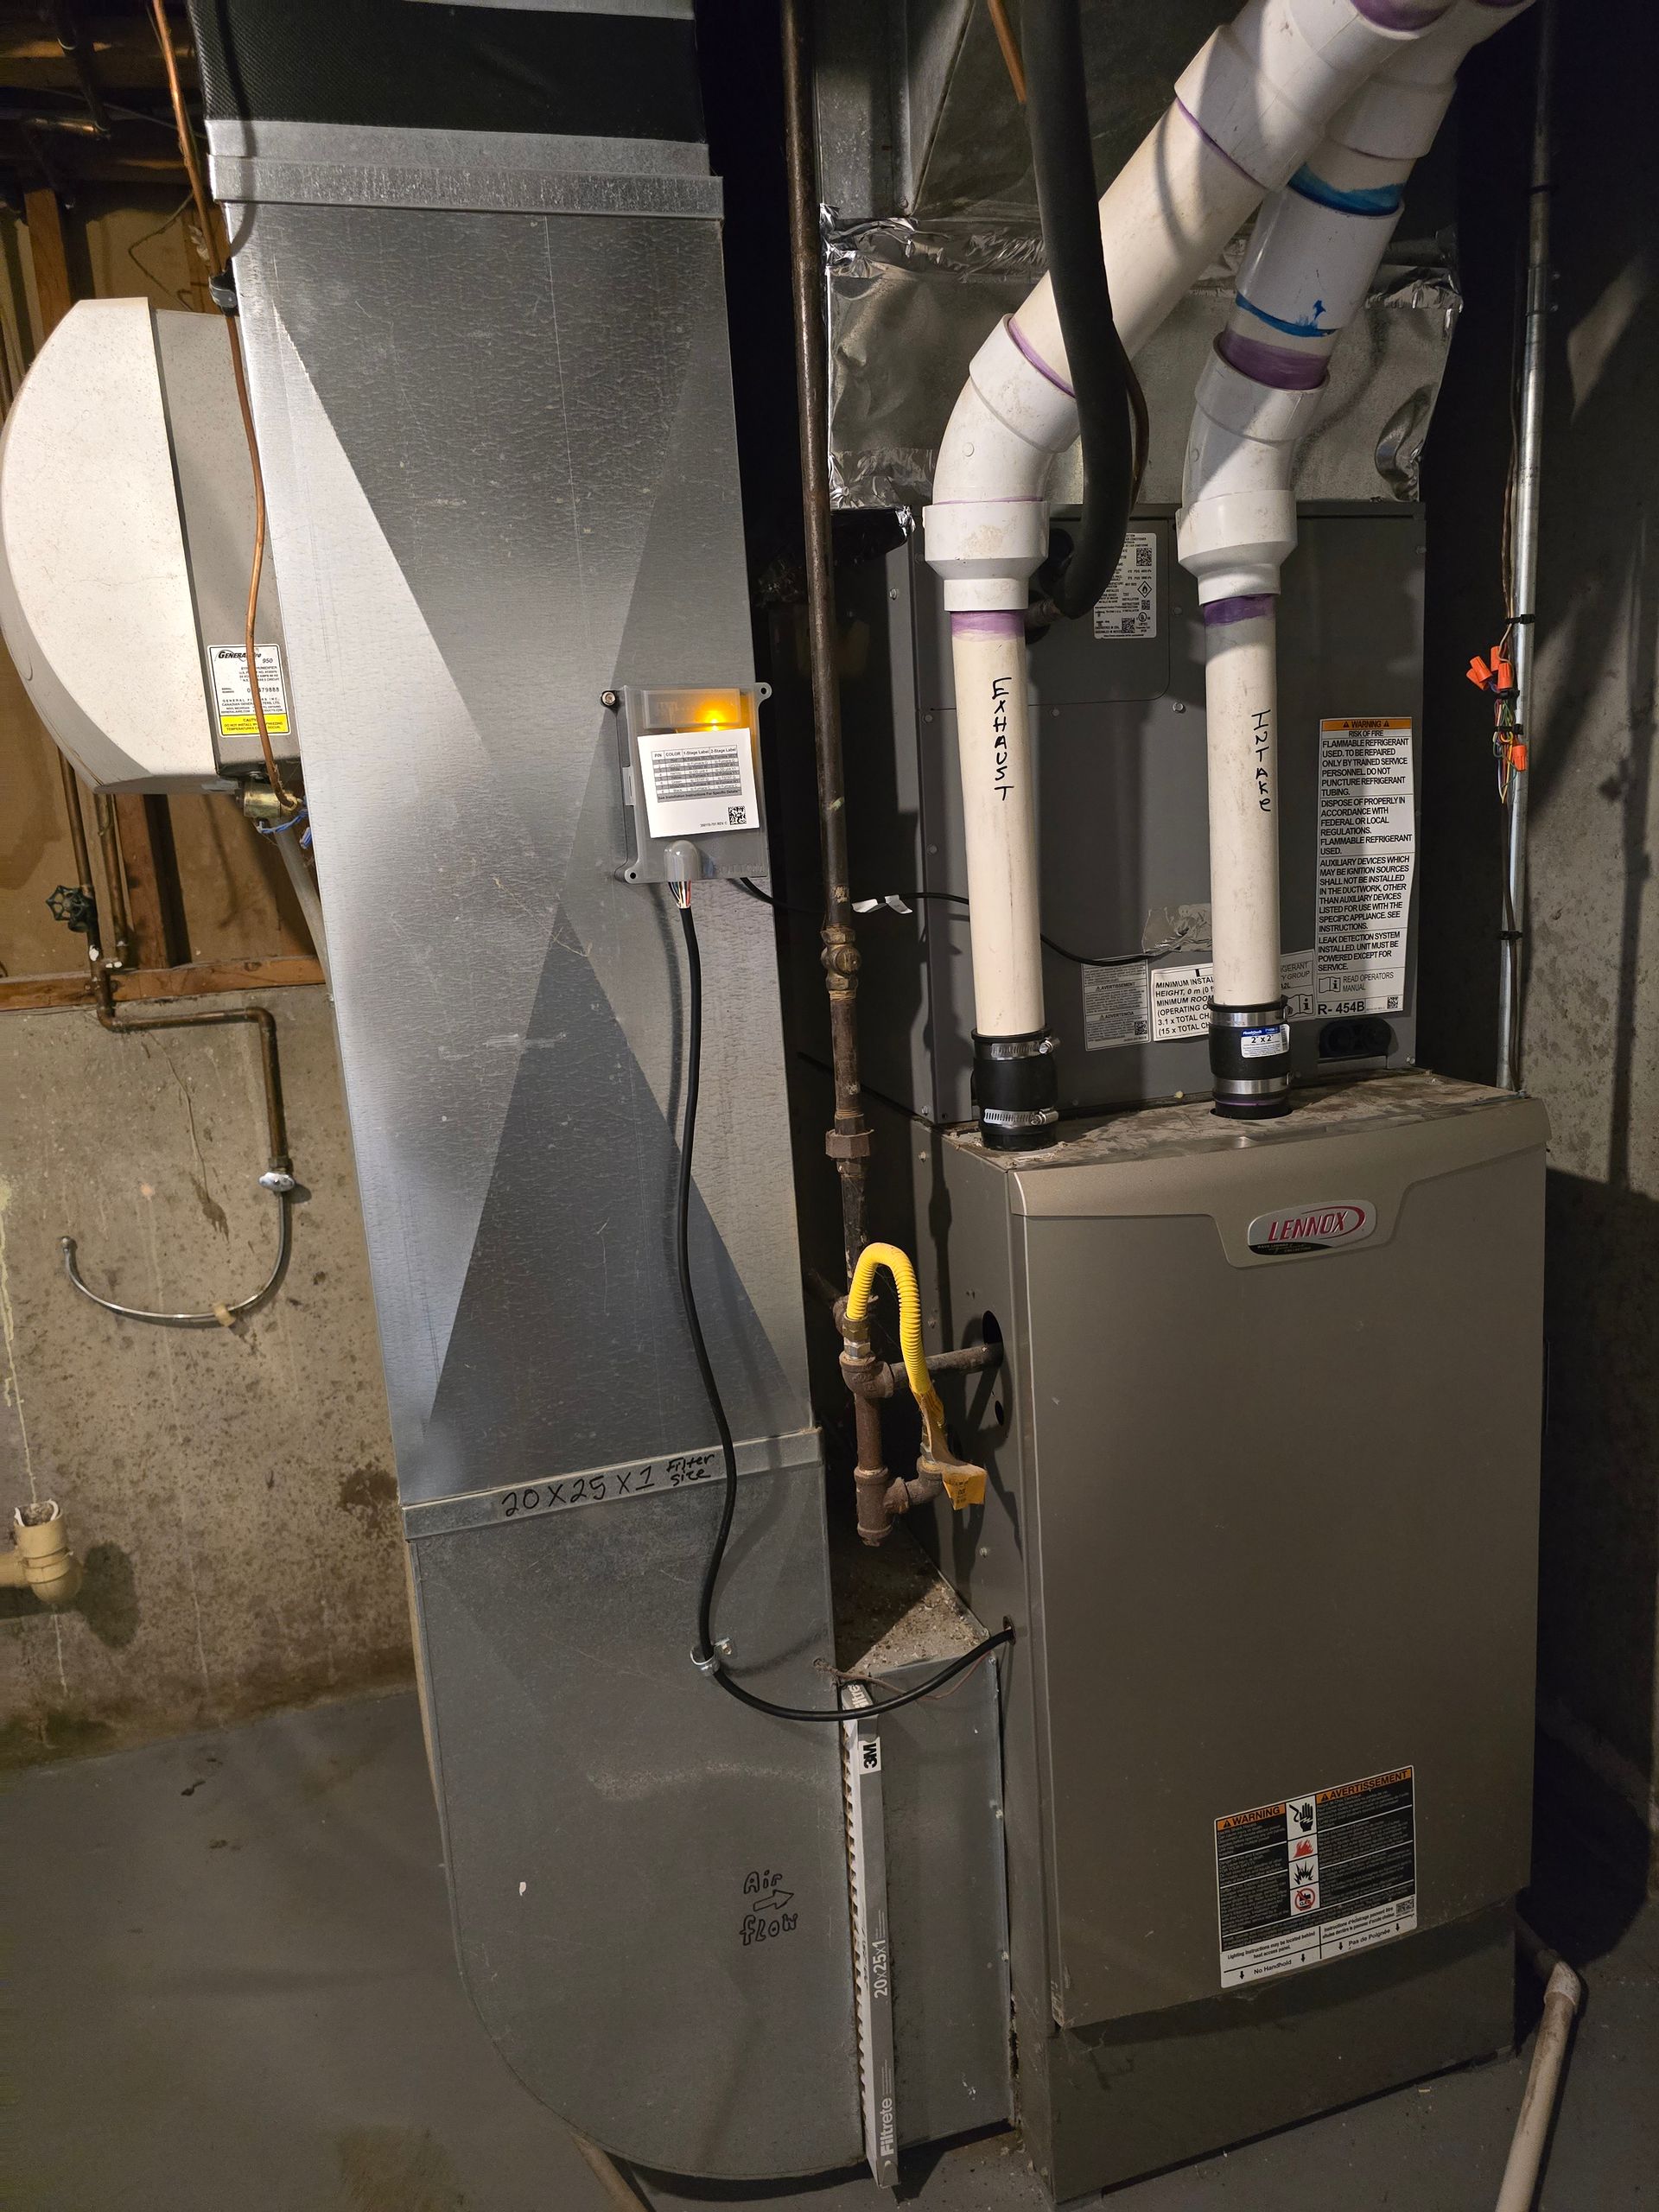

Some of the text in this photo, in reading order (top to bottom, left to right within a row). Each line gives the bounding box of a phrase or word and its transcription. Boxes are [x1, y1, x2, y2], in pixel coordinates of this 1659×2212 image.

[992, 677, 1014, 801] EXHAUST
[1322, 740, 1364, 748] FLAMMABLE
[1321, 808, 1371, 817] ACCORDANCE
[1321, 827, 1371, 836] REGULATIONS.
[1320, 835, 1412, 845] FLAMMABLE REFRIGERANT
[1321, 858, 1357, 867] AUXILIARY
[1343, 885, 1382, 893] DUCTWORK,
[1339, 894, 1373, 903] AUXILIARY
[1319, 914, 1349, 923] SPECIFIC
[1350, 912, 1386, 921] APPLIANCE.
[1319, 923, 1368, 932] INSTRUCTIONS.
[1339, 934, 1374, 943] DETECTION
[1319, 944, 1356, 953] INSTALLED.
[1319, 953, 1352, 963] POWERED
[1354, 951, 1377, 960] EXCEPT
[1156, 976, 1213, 988] MINIMUM INSTAL
[1360, 972, 1394, 982] OPERATORS
[1343, 983, 1365, 992] MANUAL
[1157, 998, 1188, 1007] MINIMUM
[1158, 1005, 1200, 1017] (OPERATING
[1176, 1014, 1198, 1023] TOTAL
[1178, 1023, 1199, 1032] TOTAL
[1268, 1211, 1348, 1242] LENNOX
[863, 1743, 877, 1769] 3M
[1330, 1770, 1408, 1799] AVERTISSEMENT
[1232, 1806, 1280, 1826] WARNING
[744, 1870, 783, 1894] Air
[1286, 1936, 1300, 1944] located
[872, 1940, 887, 1999] 20x25x1
[1264, 1960, 1292, 1972] Handhold
[880, 2097, 894, 2157] Filtrete
